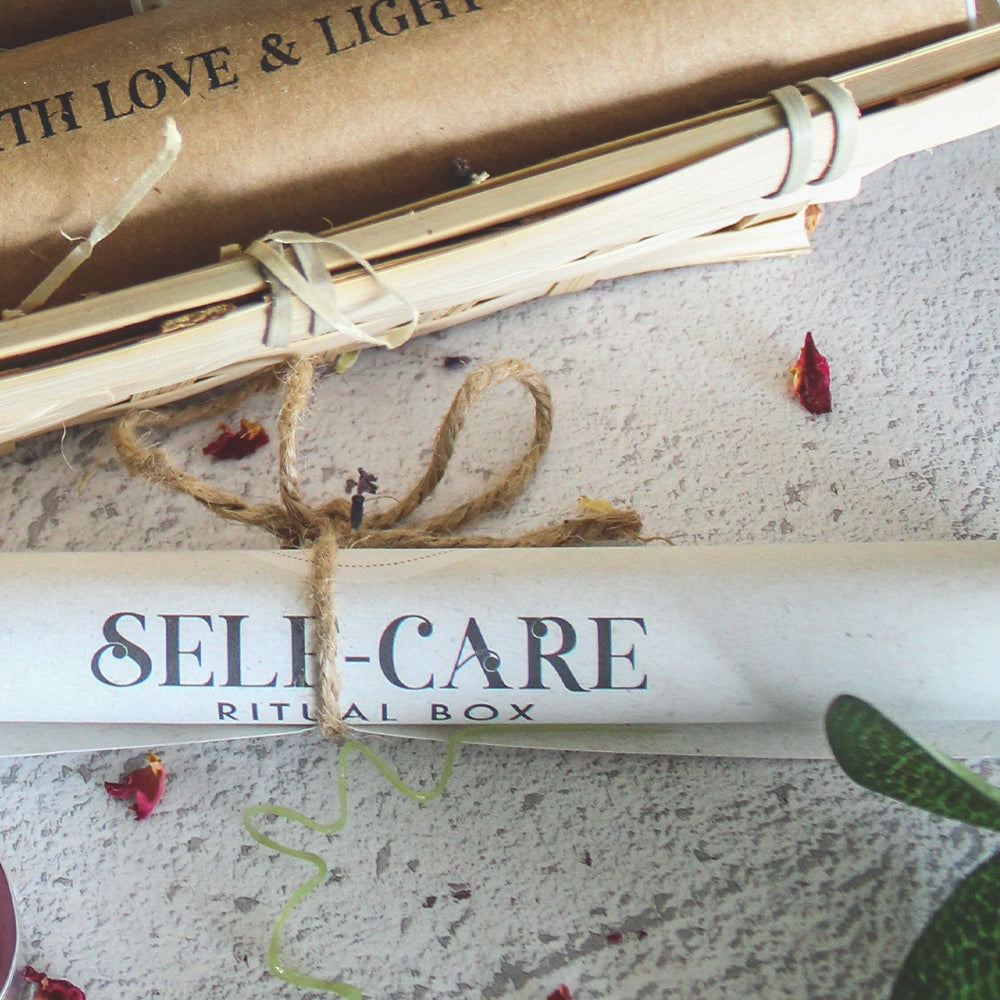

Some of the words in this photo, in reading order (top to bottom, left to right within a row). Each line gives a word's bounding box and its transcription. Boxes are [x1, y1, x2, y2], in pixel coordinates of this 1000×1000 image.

[92, 46, 240, 122] LOVE
[259, 32, 302, 73] &
[431, 702, 535, 722] BOX
